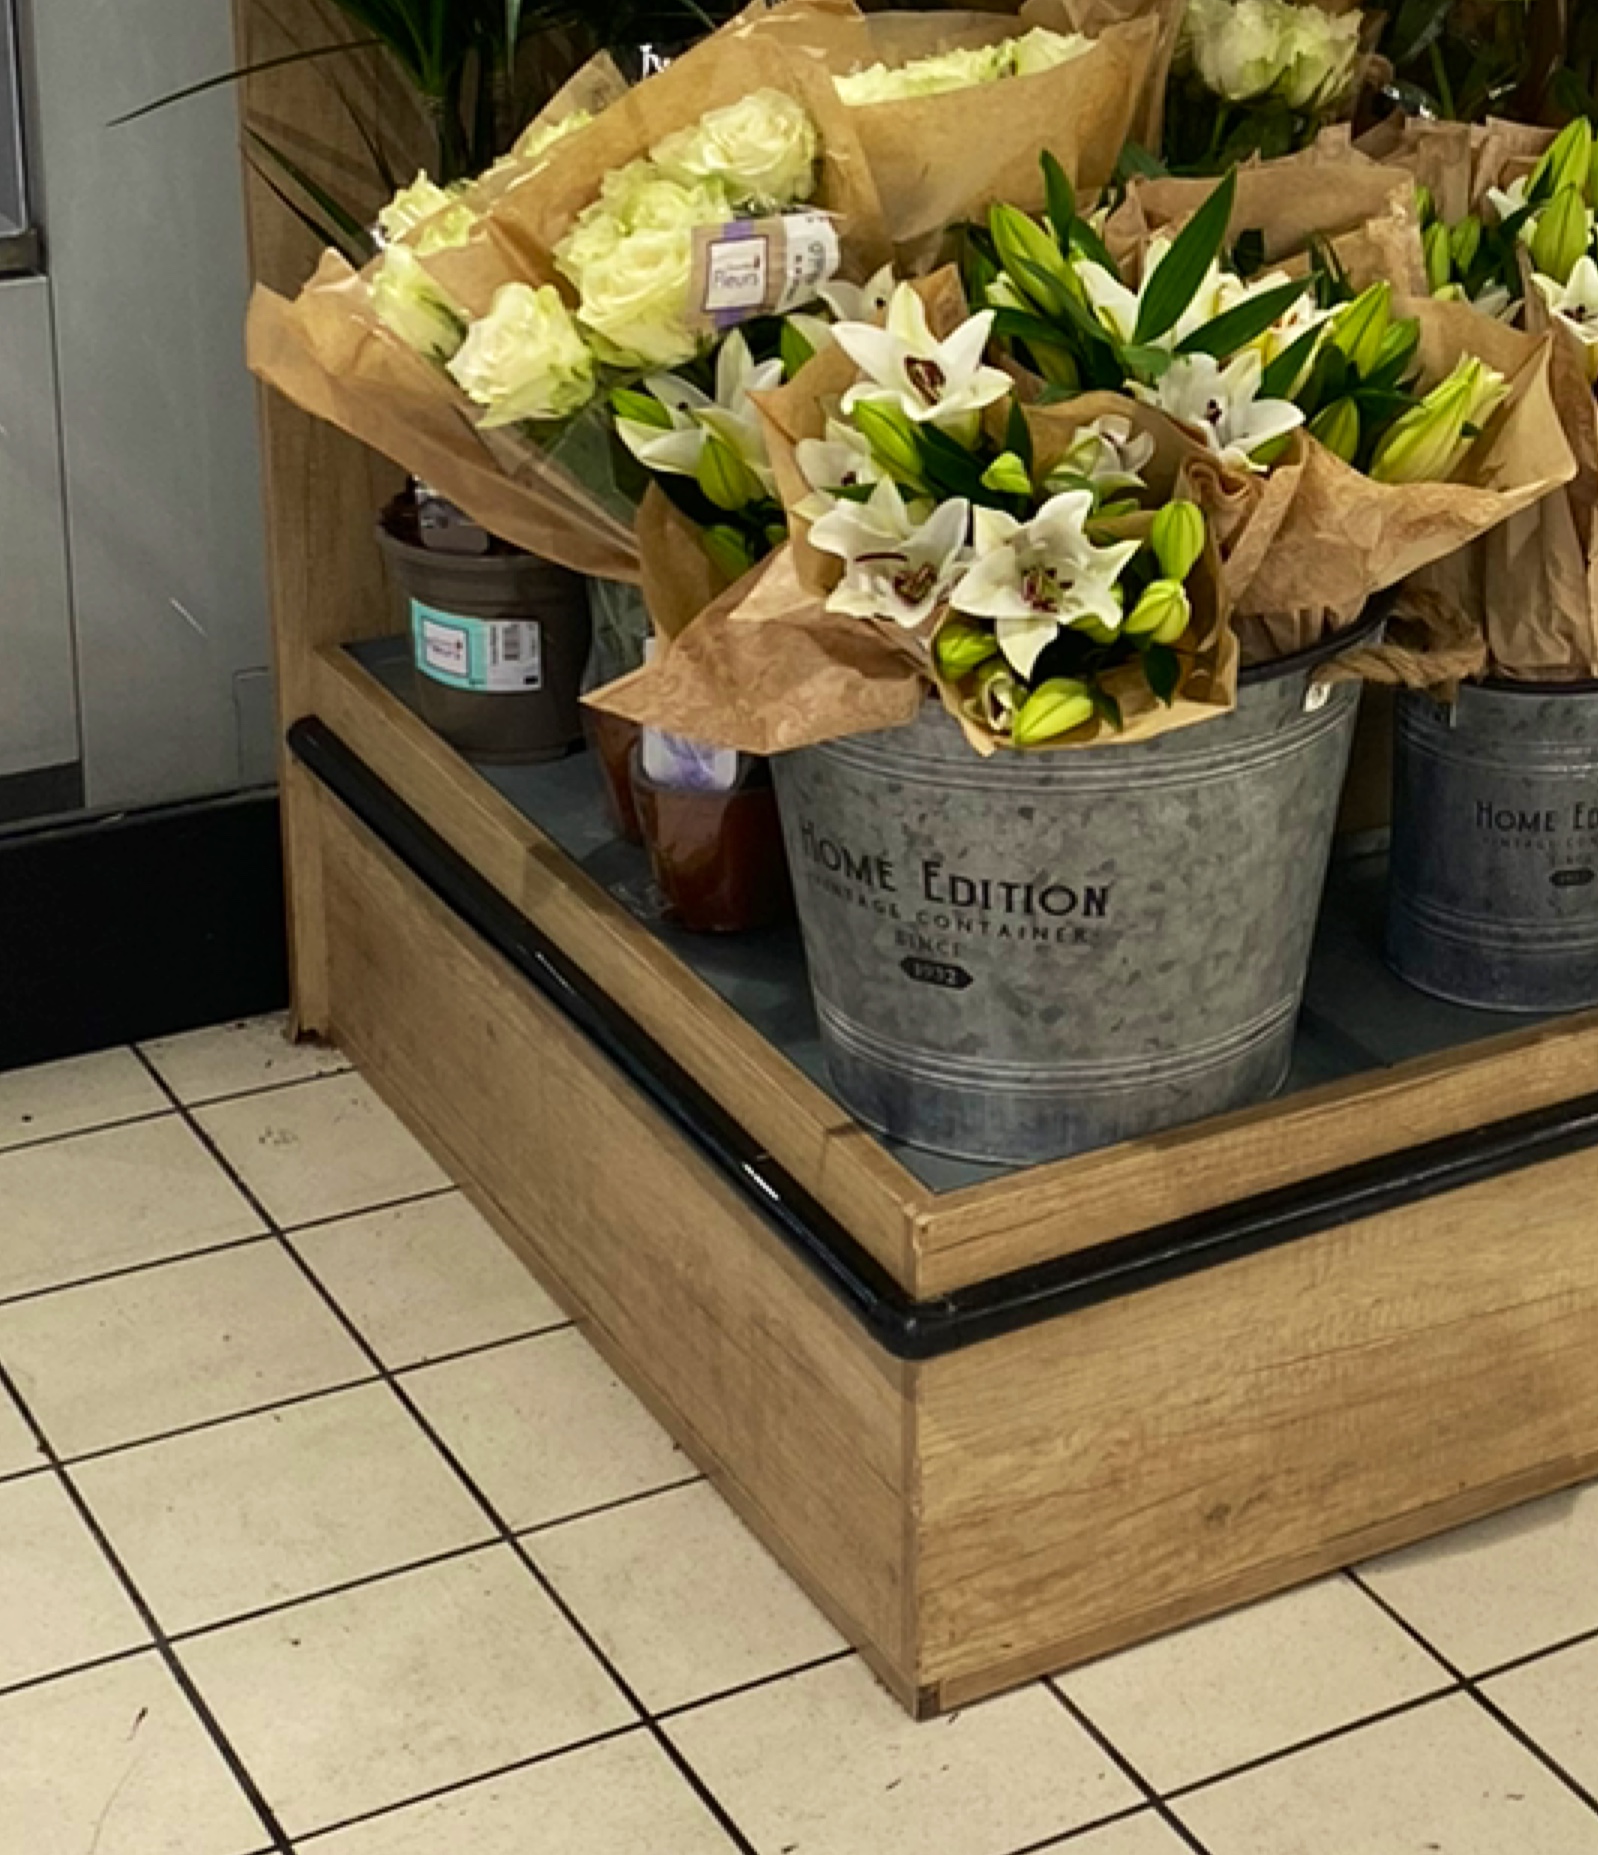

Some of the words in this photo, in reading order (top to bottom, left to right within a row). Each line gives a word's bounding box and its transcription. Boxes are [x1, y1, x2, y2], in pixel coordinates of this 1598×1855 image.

[1476, 800, 1556, 833] HOME
[800, 820, 897, 892] HOME
[922, 858, 1110, 917] EDITION
[916, 909, 1089, 943] CONTAINER
